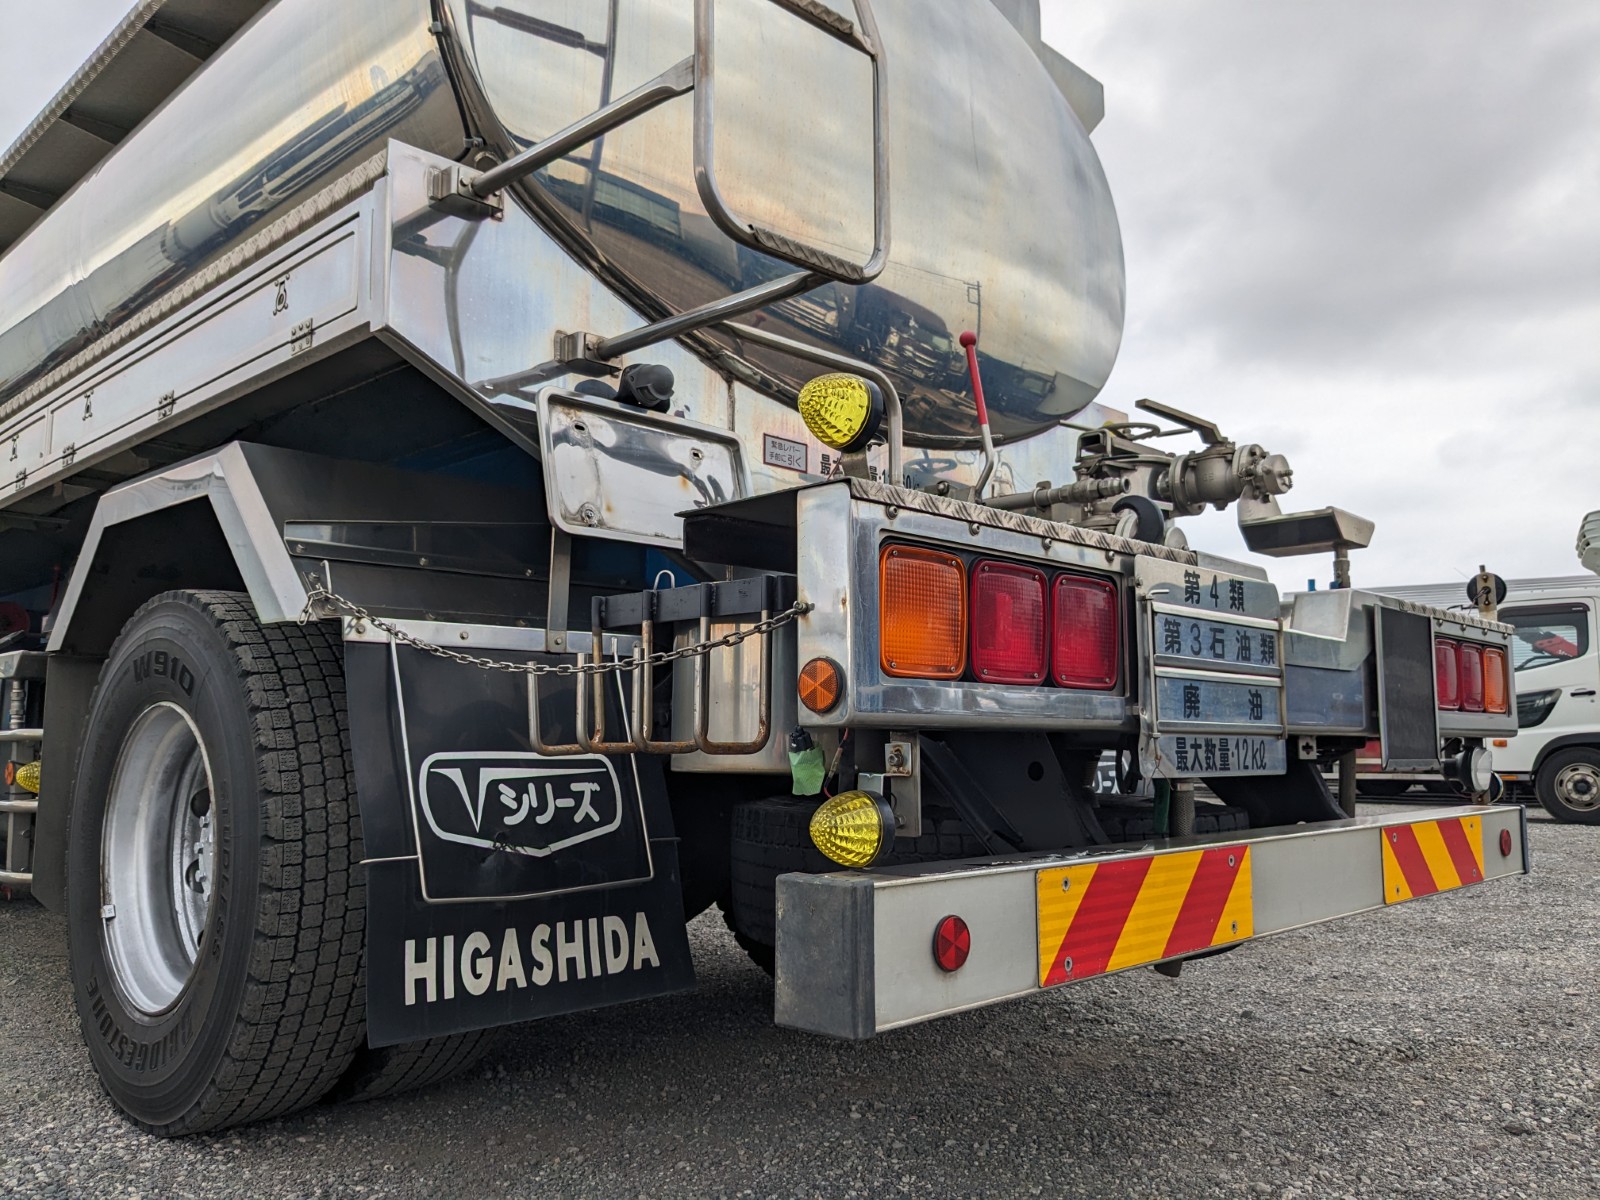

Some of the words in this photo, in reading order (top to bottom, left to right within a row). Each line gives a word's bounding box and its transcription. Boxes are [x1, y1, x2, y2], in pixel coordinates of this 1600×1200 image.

[769, 451, 802, 468] 手前に引く
[1163, 617, 1276, 665] 第3石油類
[133, 650, 195, 696] W910
[404, 911, 660, 1006] HIGASHIDA
[85, 976, 194, 1073] BRIDGESTONE
